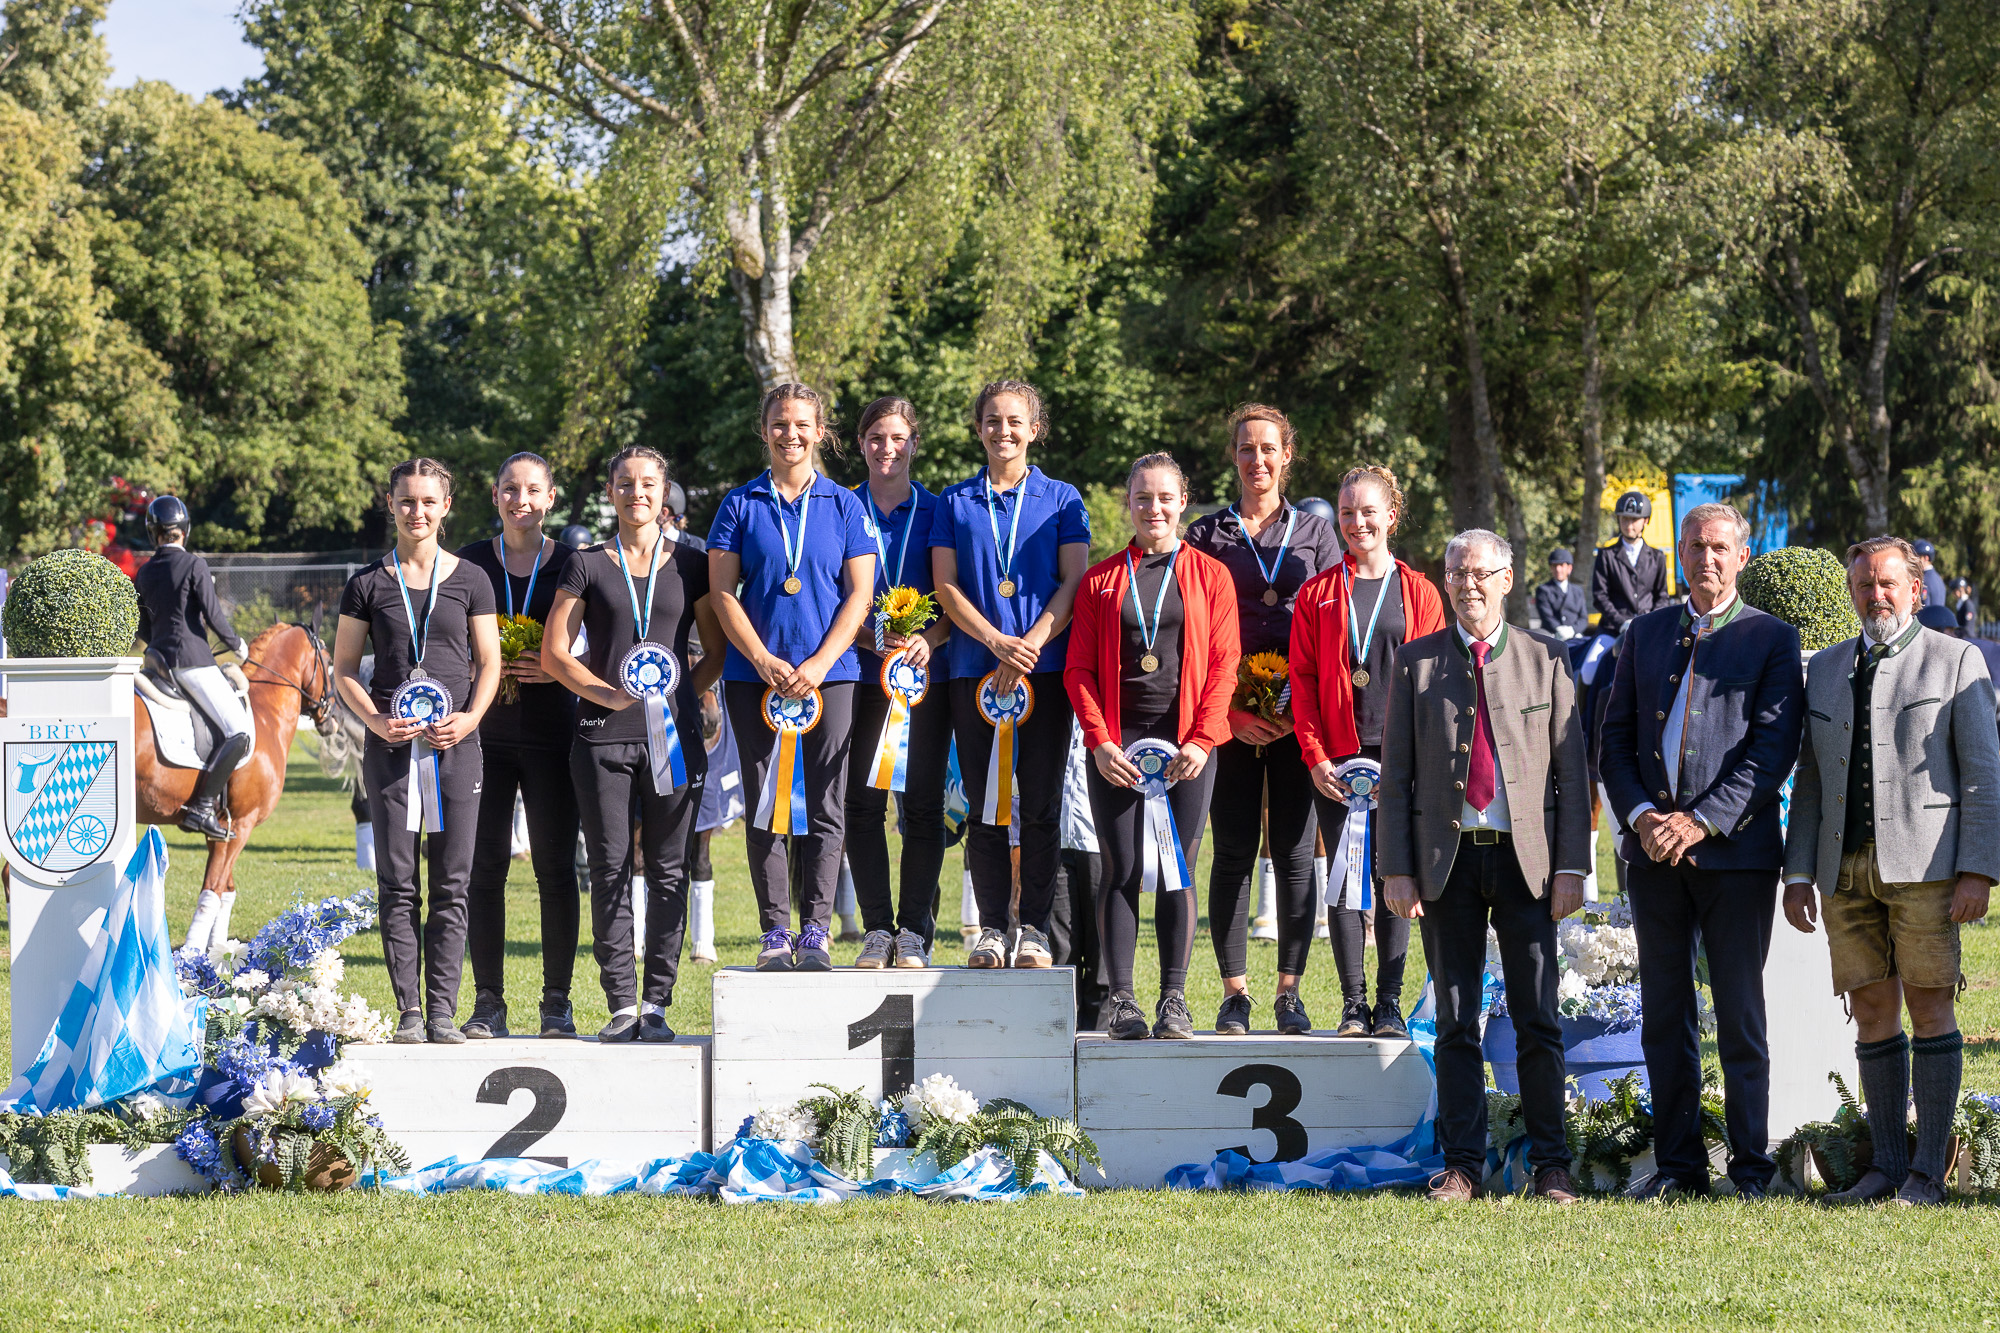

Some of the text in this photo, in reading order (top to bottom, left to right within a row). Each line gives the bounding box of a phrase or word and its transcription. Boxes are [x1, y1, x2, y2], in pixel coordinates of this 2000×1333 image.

[29, 724, 91, 739] BRFV
[579, 717, 606, 728] Charly
[848, 994, 915, 1098] 1
[475, 1066, 568, 1168] 2
[1215, 1063, 1308, 1163] 3
